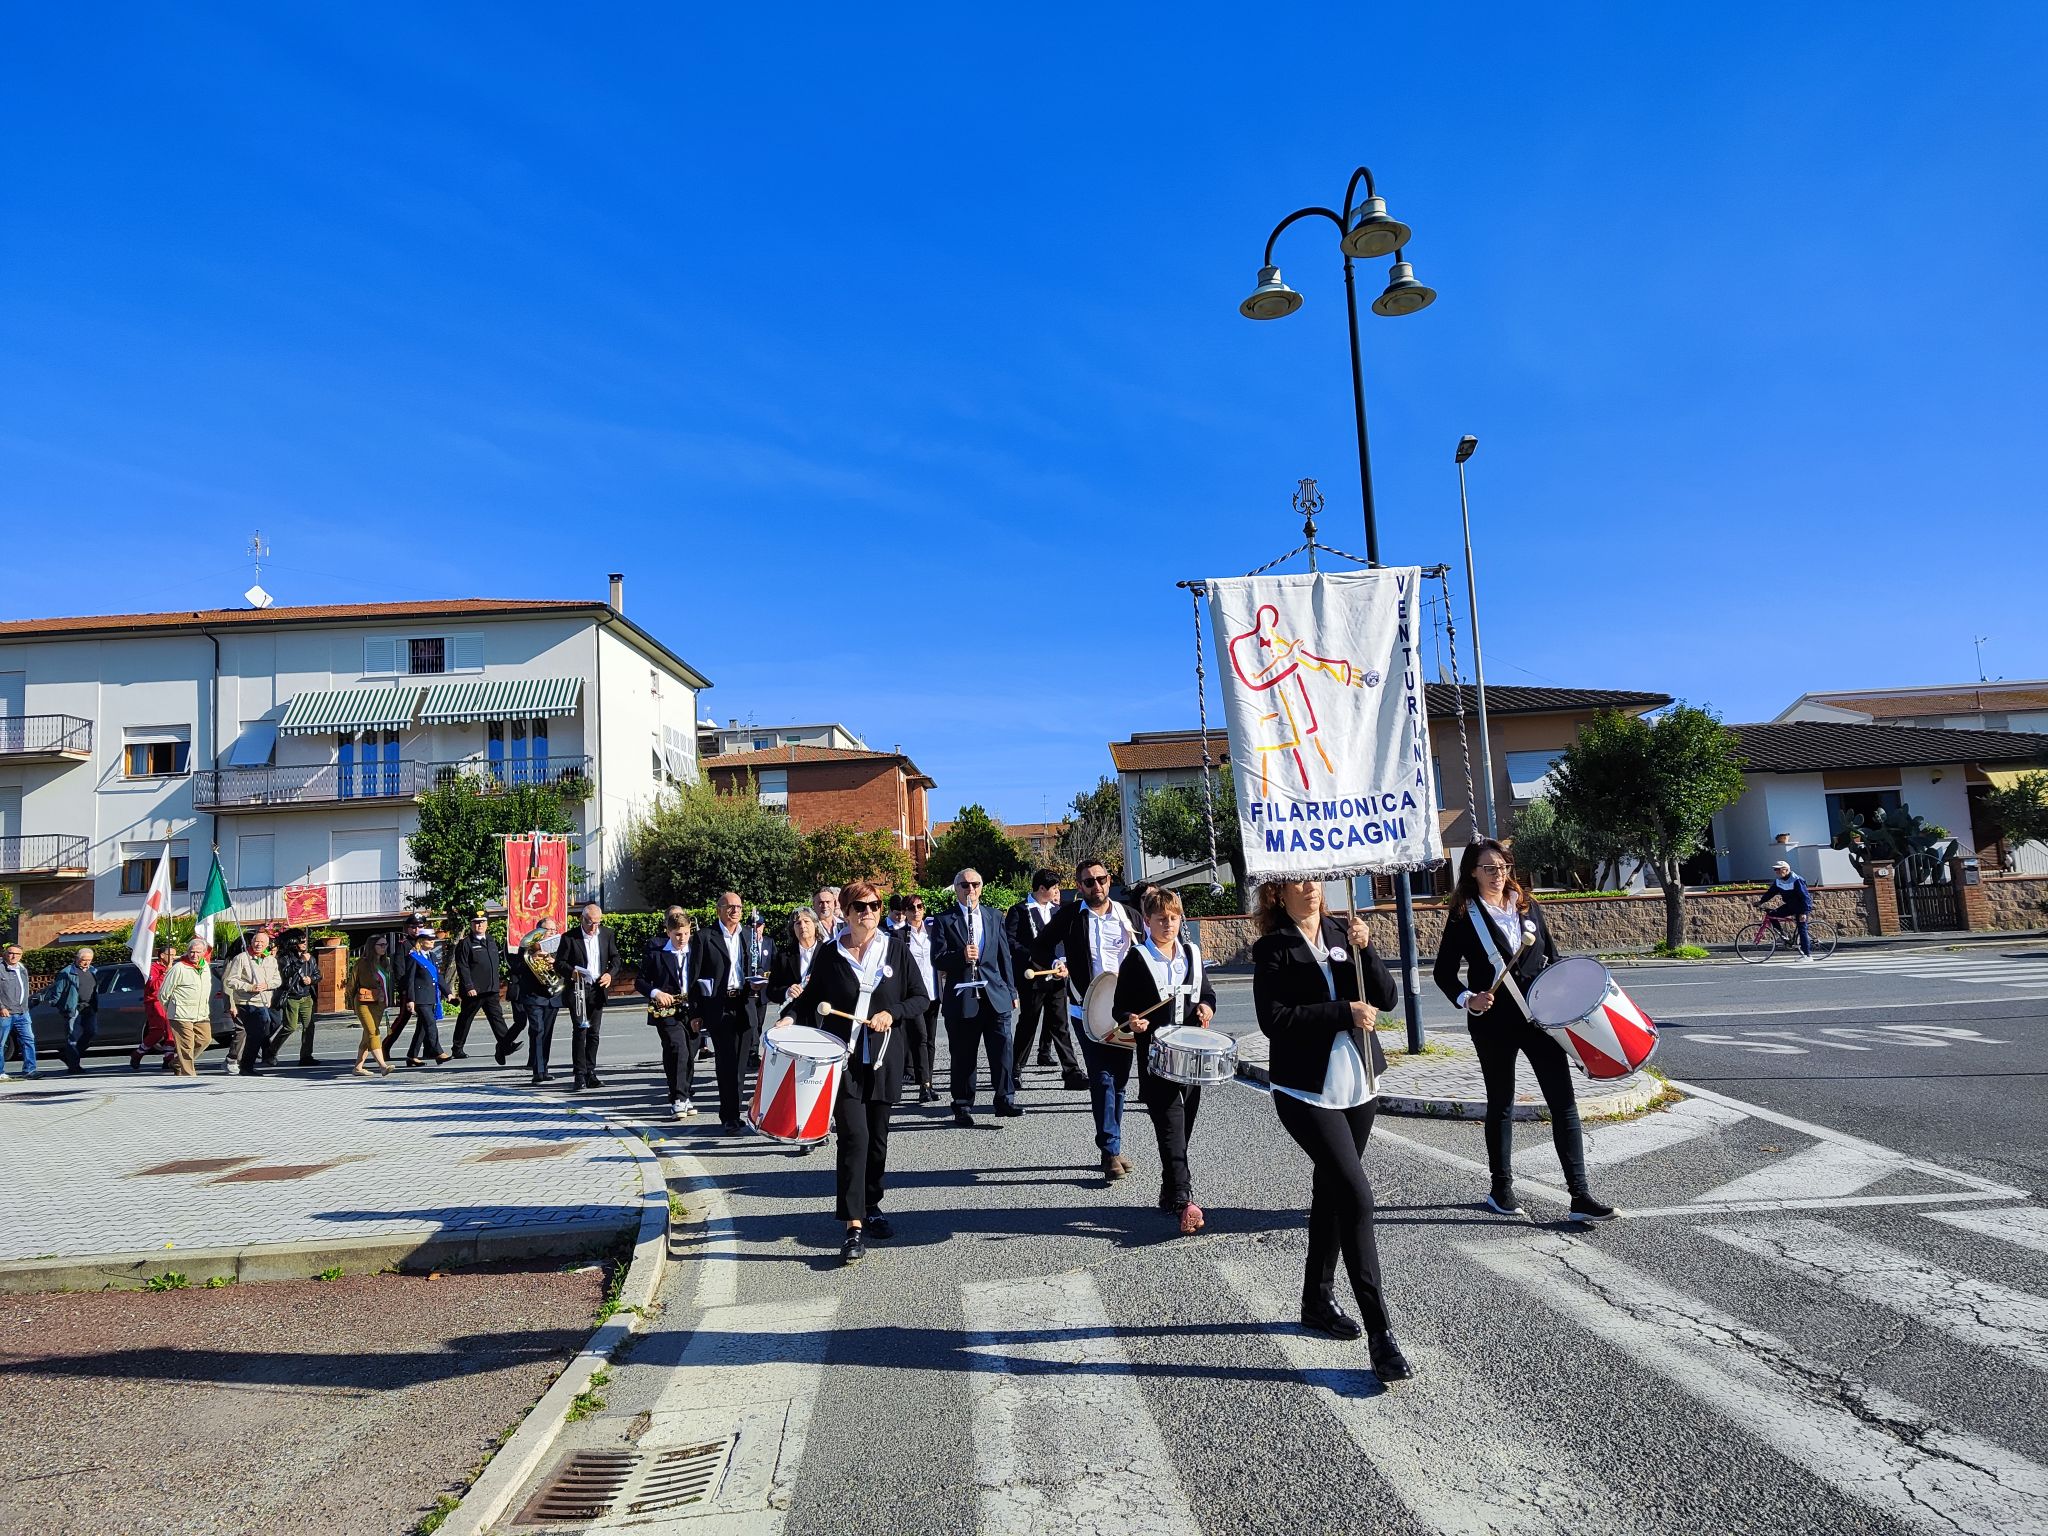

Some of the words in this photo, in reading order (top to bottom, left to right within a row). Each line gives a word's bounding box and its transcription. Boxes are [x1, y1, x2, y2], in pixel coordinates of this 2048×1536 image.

[1395, 575, 1424, 787] VENTURINA
[1250, 790, 1417, 823] FILARMONICA
[1265, 817, 1407, 853] MASCAGNI
[1681, 1025, 2013, 1055] STOP
